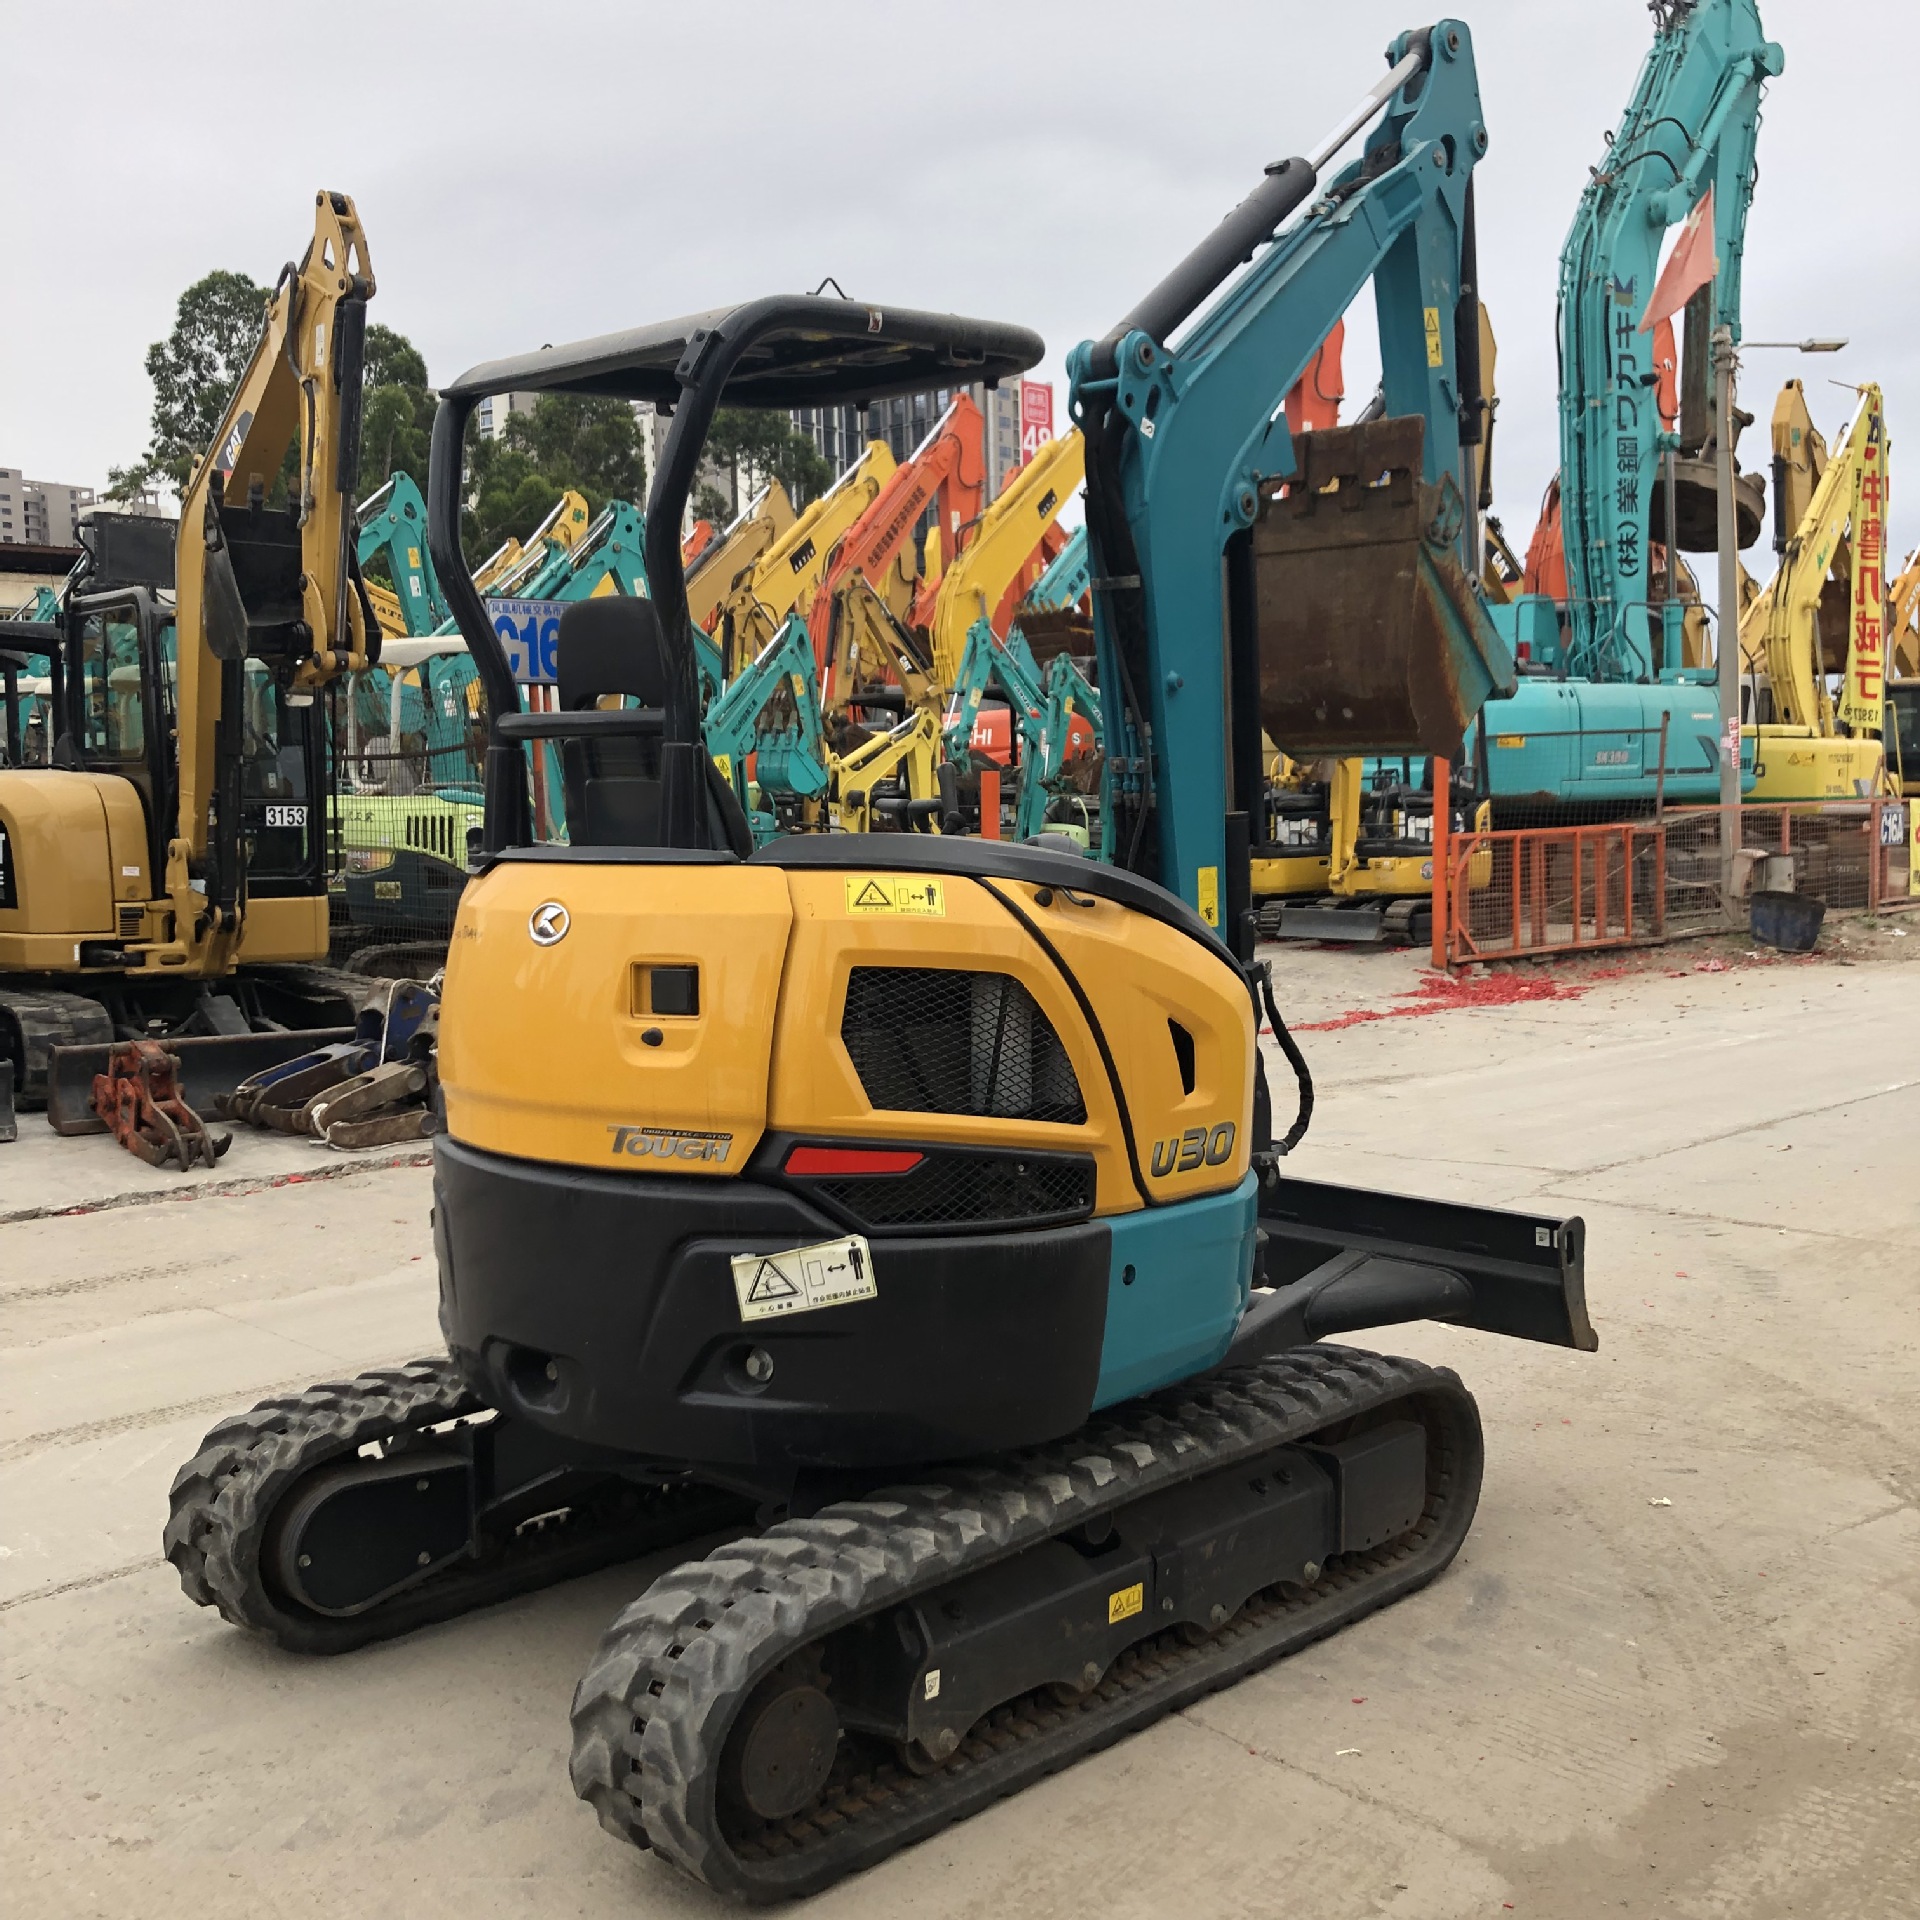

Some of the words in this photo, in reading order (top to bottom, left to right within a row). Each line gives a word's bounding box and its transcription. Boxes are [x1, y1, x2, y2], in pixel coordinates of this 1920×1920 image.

[225, 423, 242, 467] CAT
[899, 655, 912, 672] CAT
[267, 807, 305, 826] 3153
[1881, 812, 1904, 844] C16A
[643, 1128, 674, 1137] URBAN
[1151, 1121, 1236, 1177] U30
